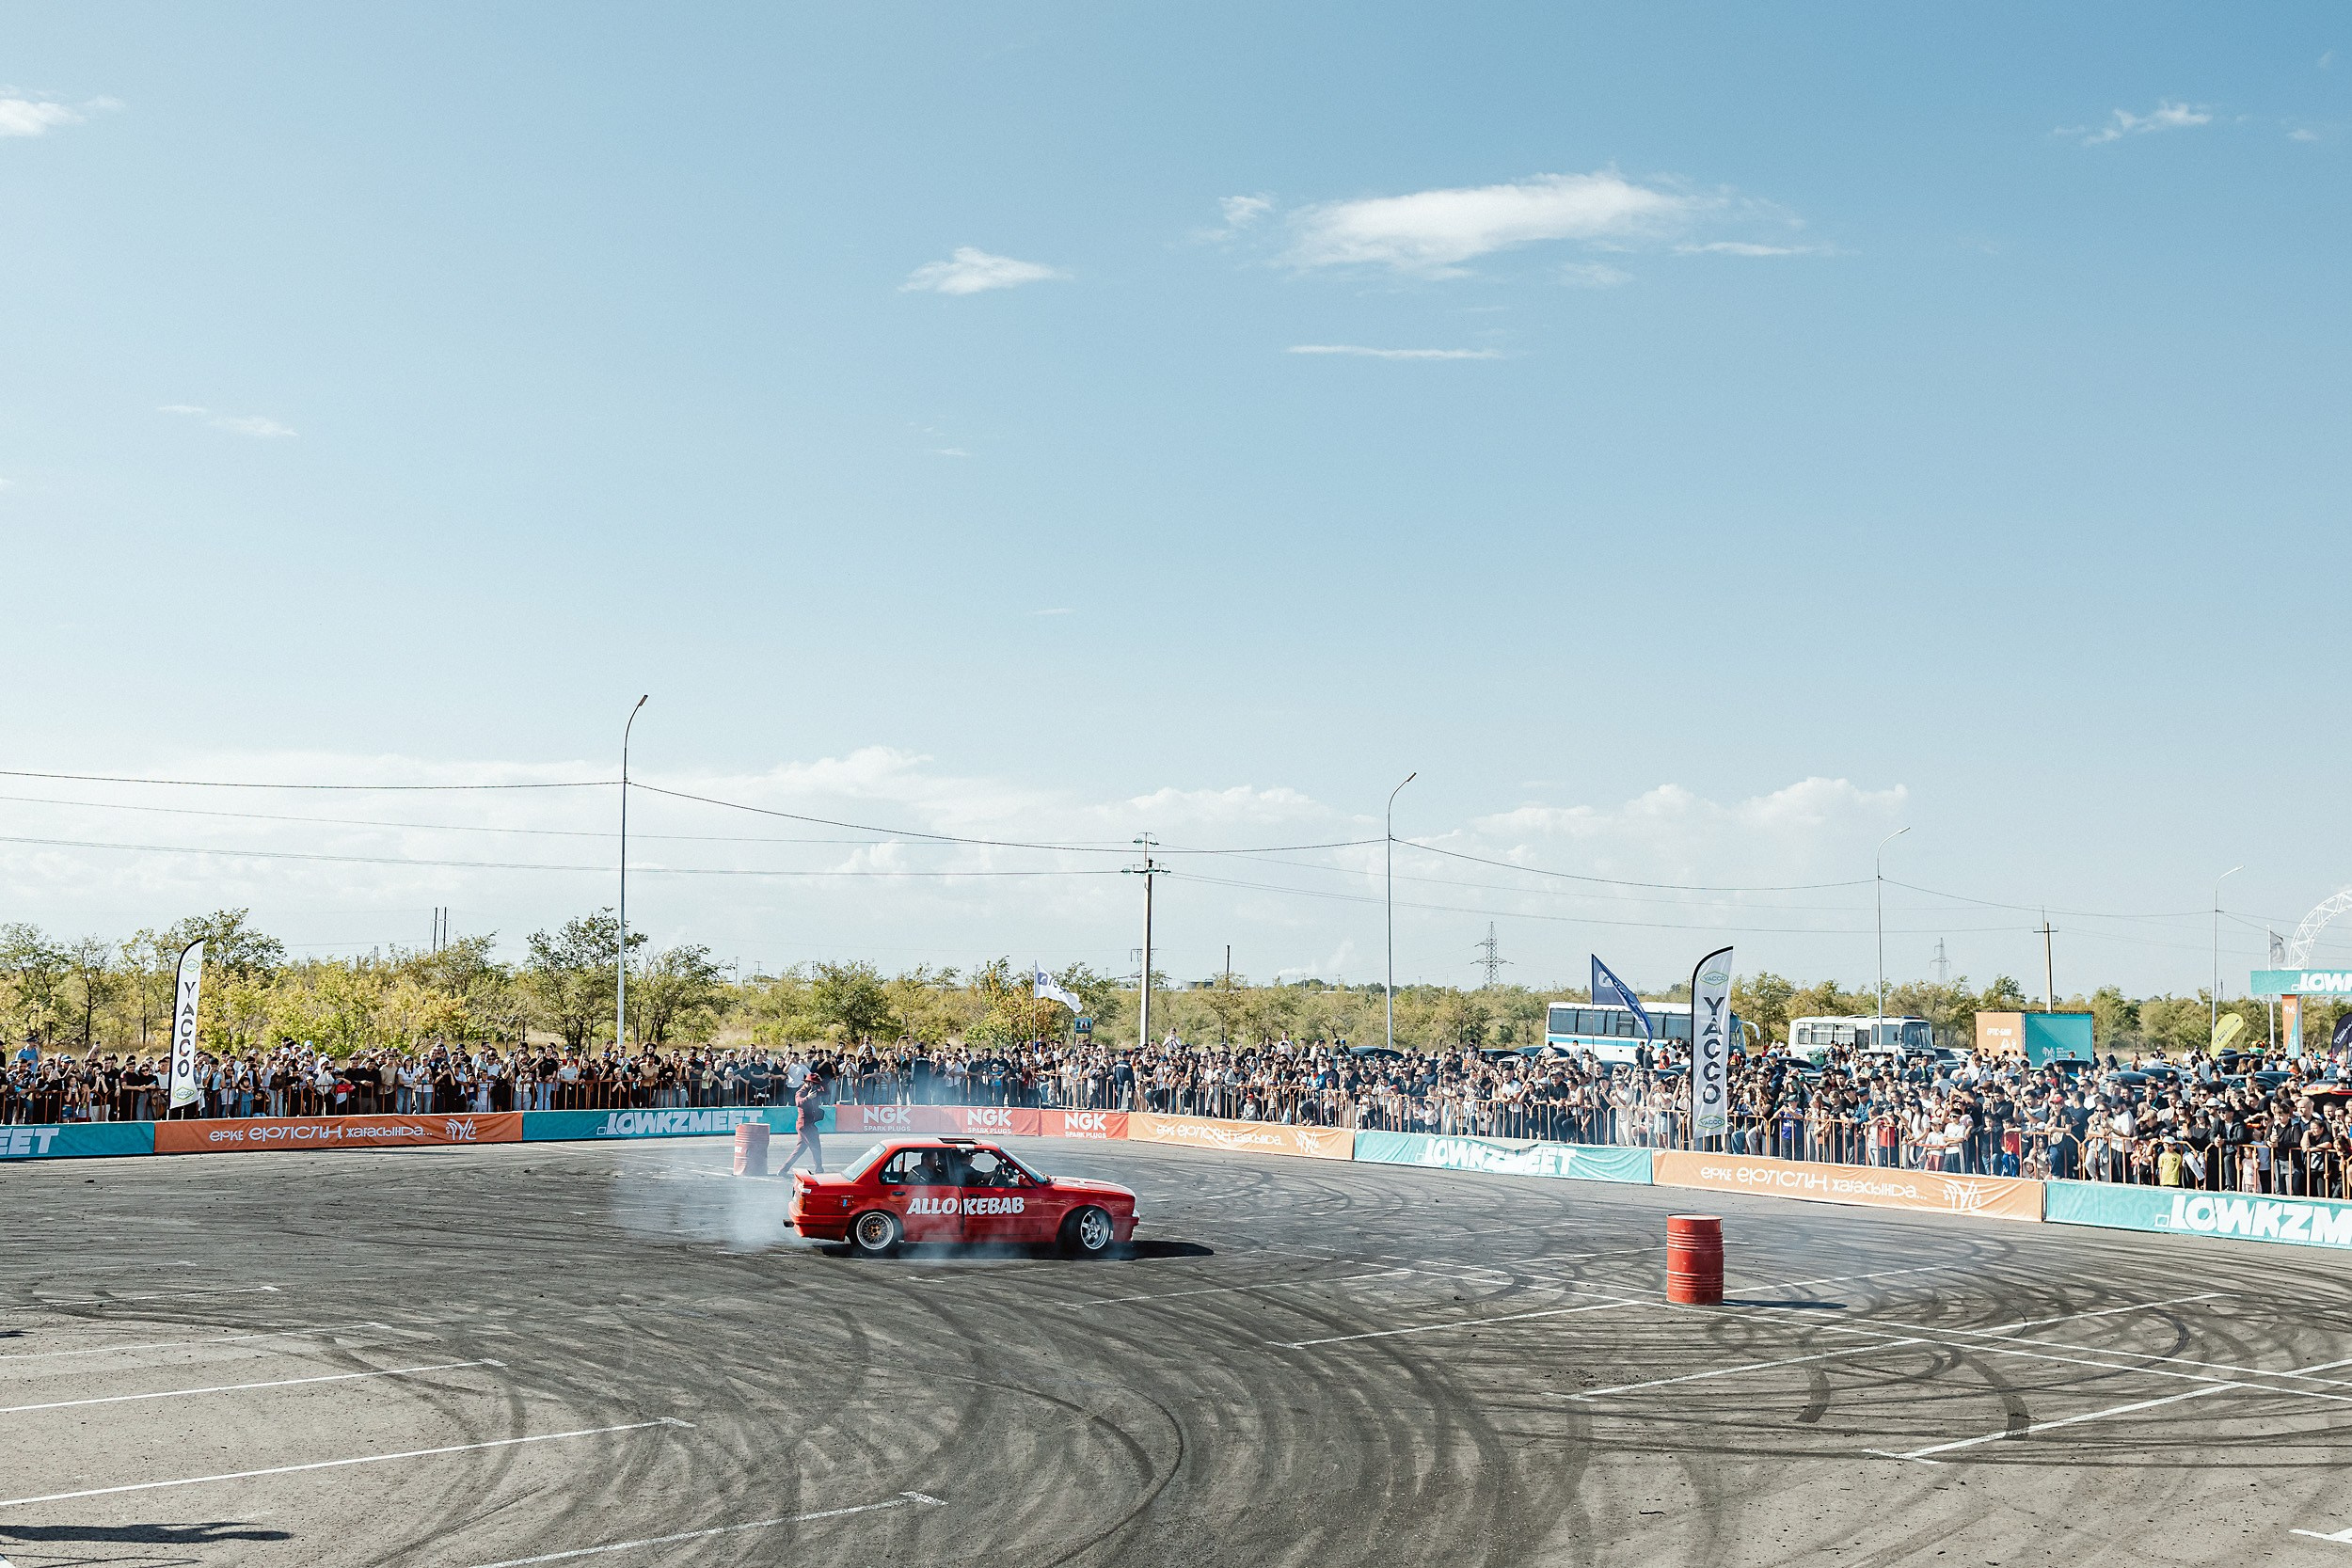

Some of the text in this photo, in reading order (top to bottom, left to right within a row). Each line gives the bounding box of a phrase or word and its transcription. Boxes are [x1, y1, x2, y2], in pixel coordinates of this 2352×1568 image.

[177, 981, 196, 1078] YACCO
[1702, 996, 1724, 1105] YACCO
[864, 1106, 912, 1125] NGK
[968, 1108, 1012, 1127] NGK
[1065, 1112, 1107, 1131] NGK
[906, 1196, 1025, 1215] ALLO KEBAB
[2169, 1195, 2352, 1244] LOWKZM
